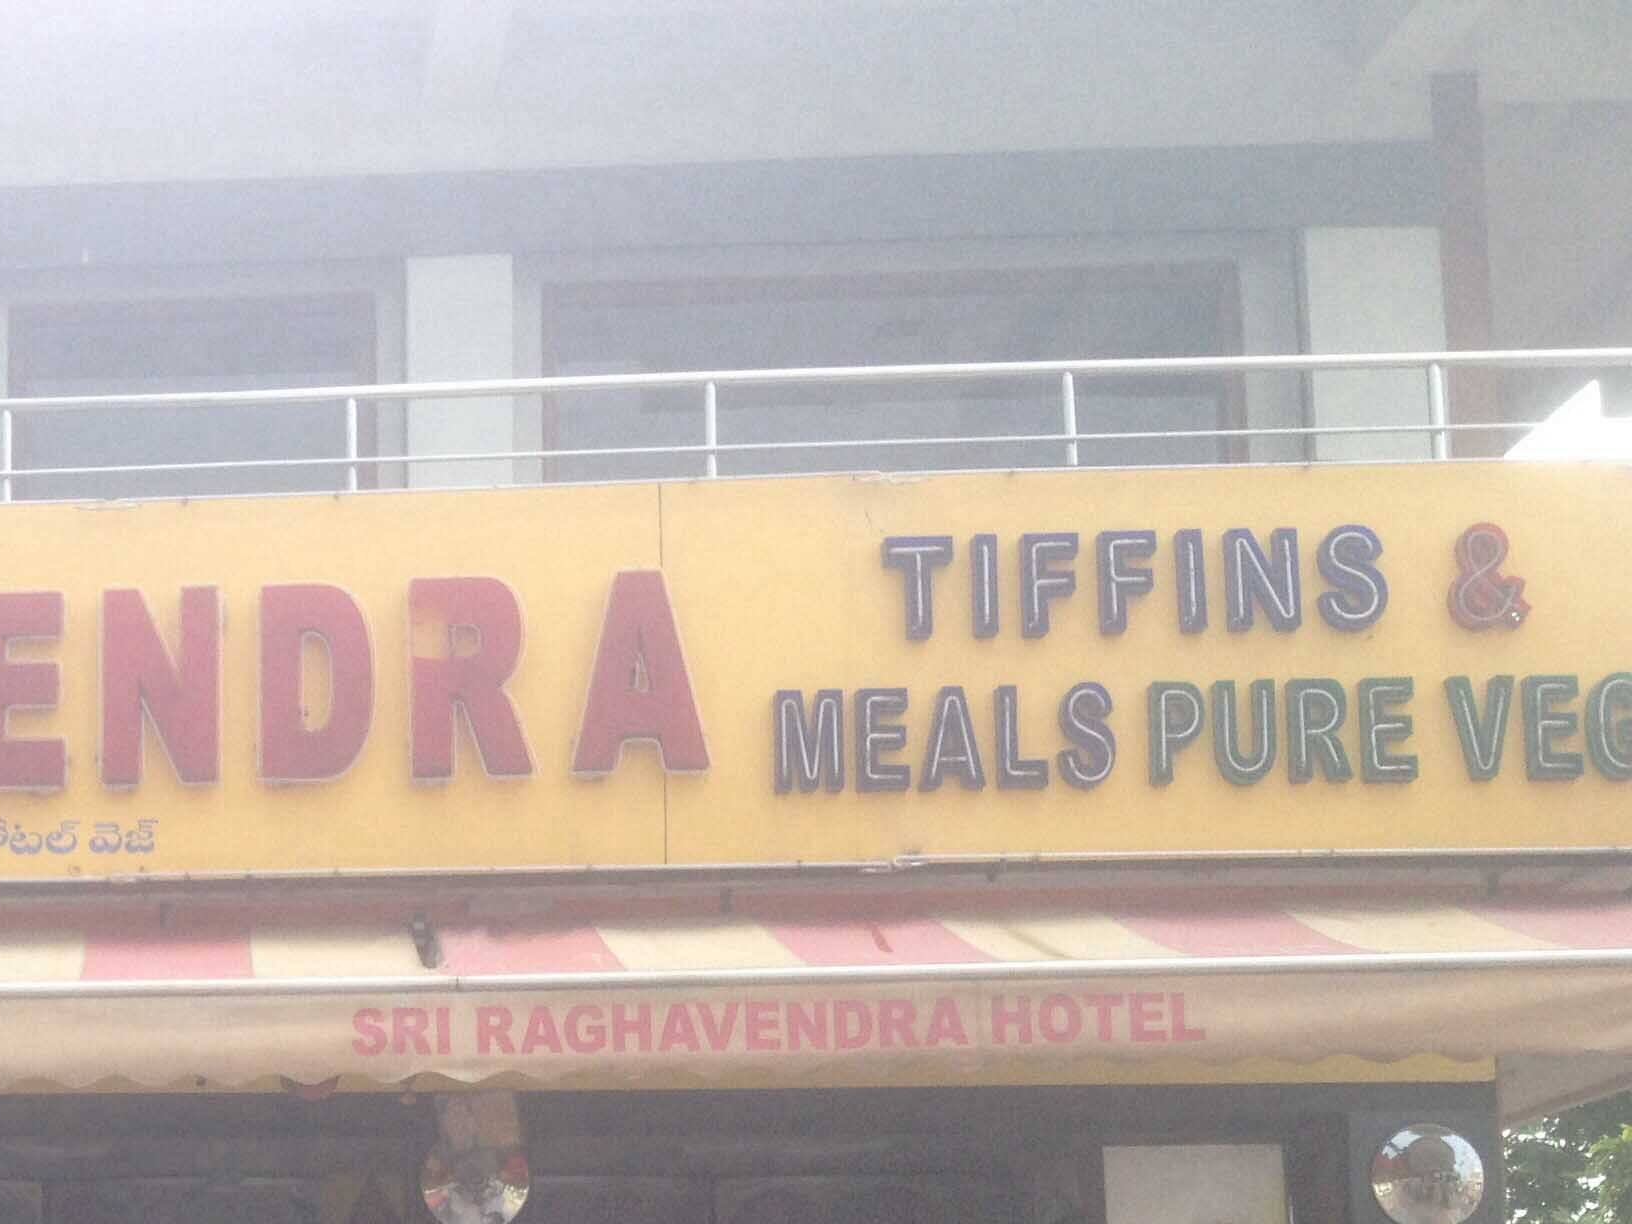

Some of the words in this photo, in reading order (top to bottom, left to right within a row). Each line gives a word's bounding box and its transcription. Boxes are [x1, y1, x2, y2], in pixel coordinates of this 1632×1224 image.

[881, 523, 1390, 642] TIFFINS
[1447, 522, 1533, 632] &
[772, 681, 1117, 794] MEALS
[1147, 676, 1419, 789] PURE
[351, 1006, 451, 1057] SRI
[475, 998, 970, 1057] RAGHAVENDRA
[990, 991, 1207, 1046] HOTEL
